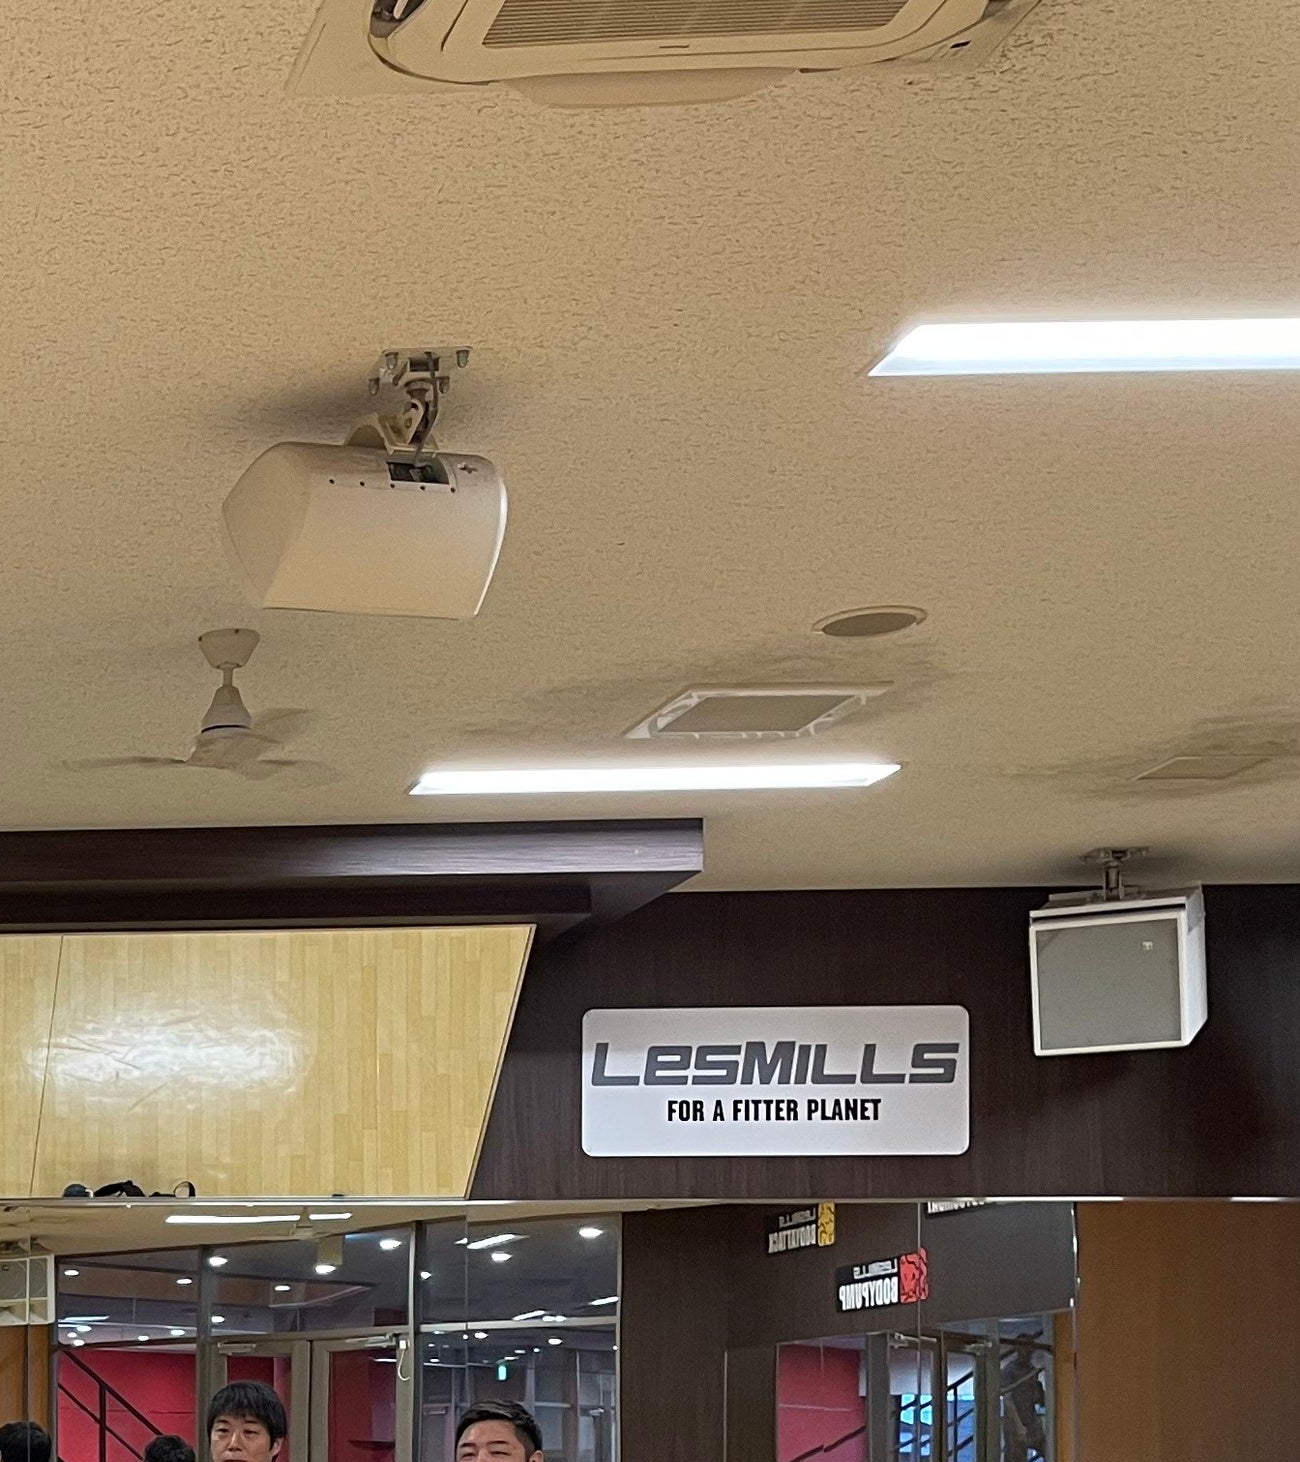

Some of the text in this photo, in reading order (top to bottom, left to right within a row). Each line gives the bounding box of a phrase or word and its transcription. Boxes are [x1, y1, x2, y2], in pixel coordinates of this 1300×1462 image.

[667, 1098, 882, 1122] FOR A FITTER PLANET
